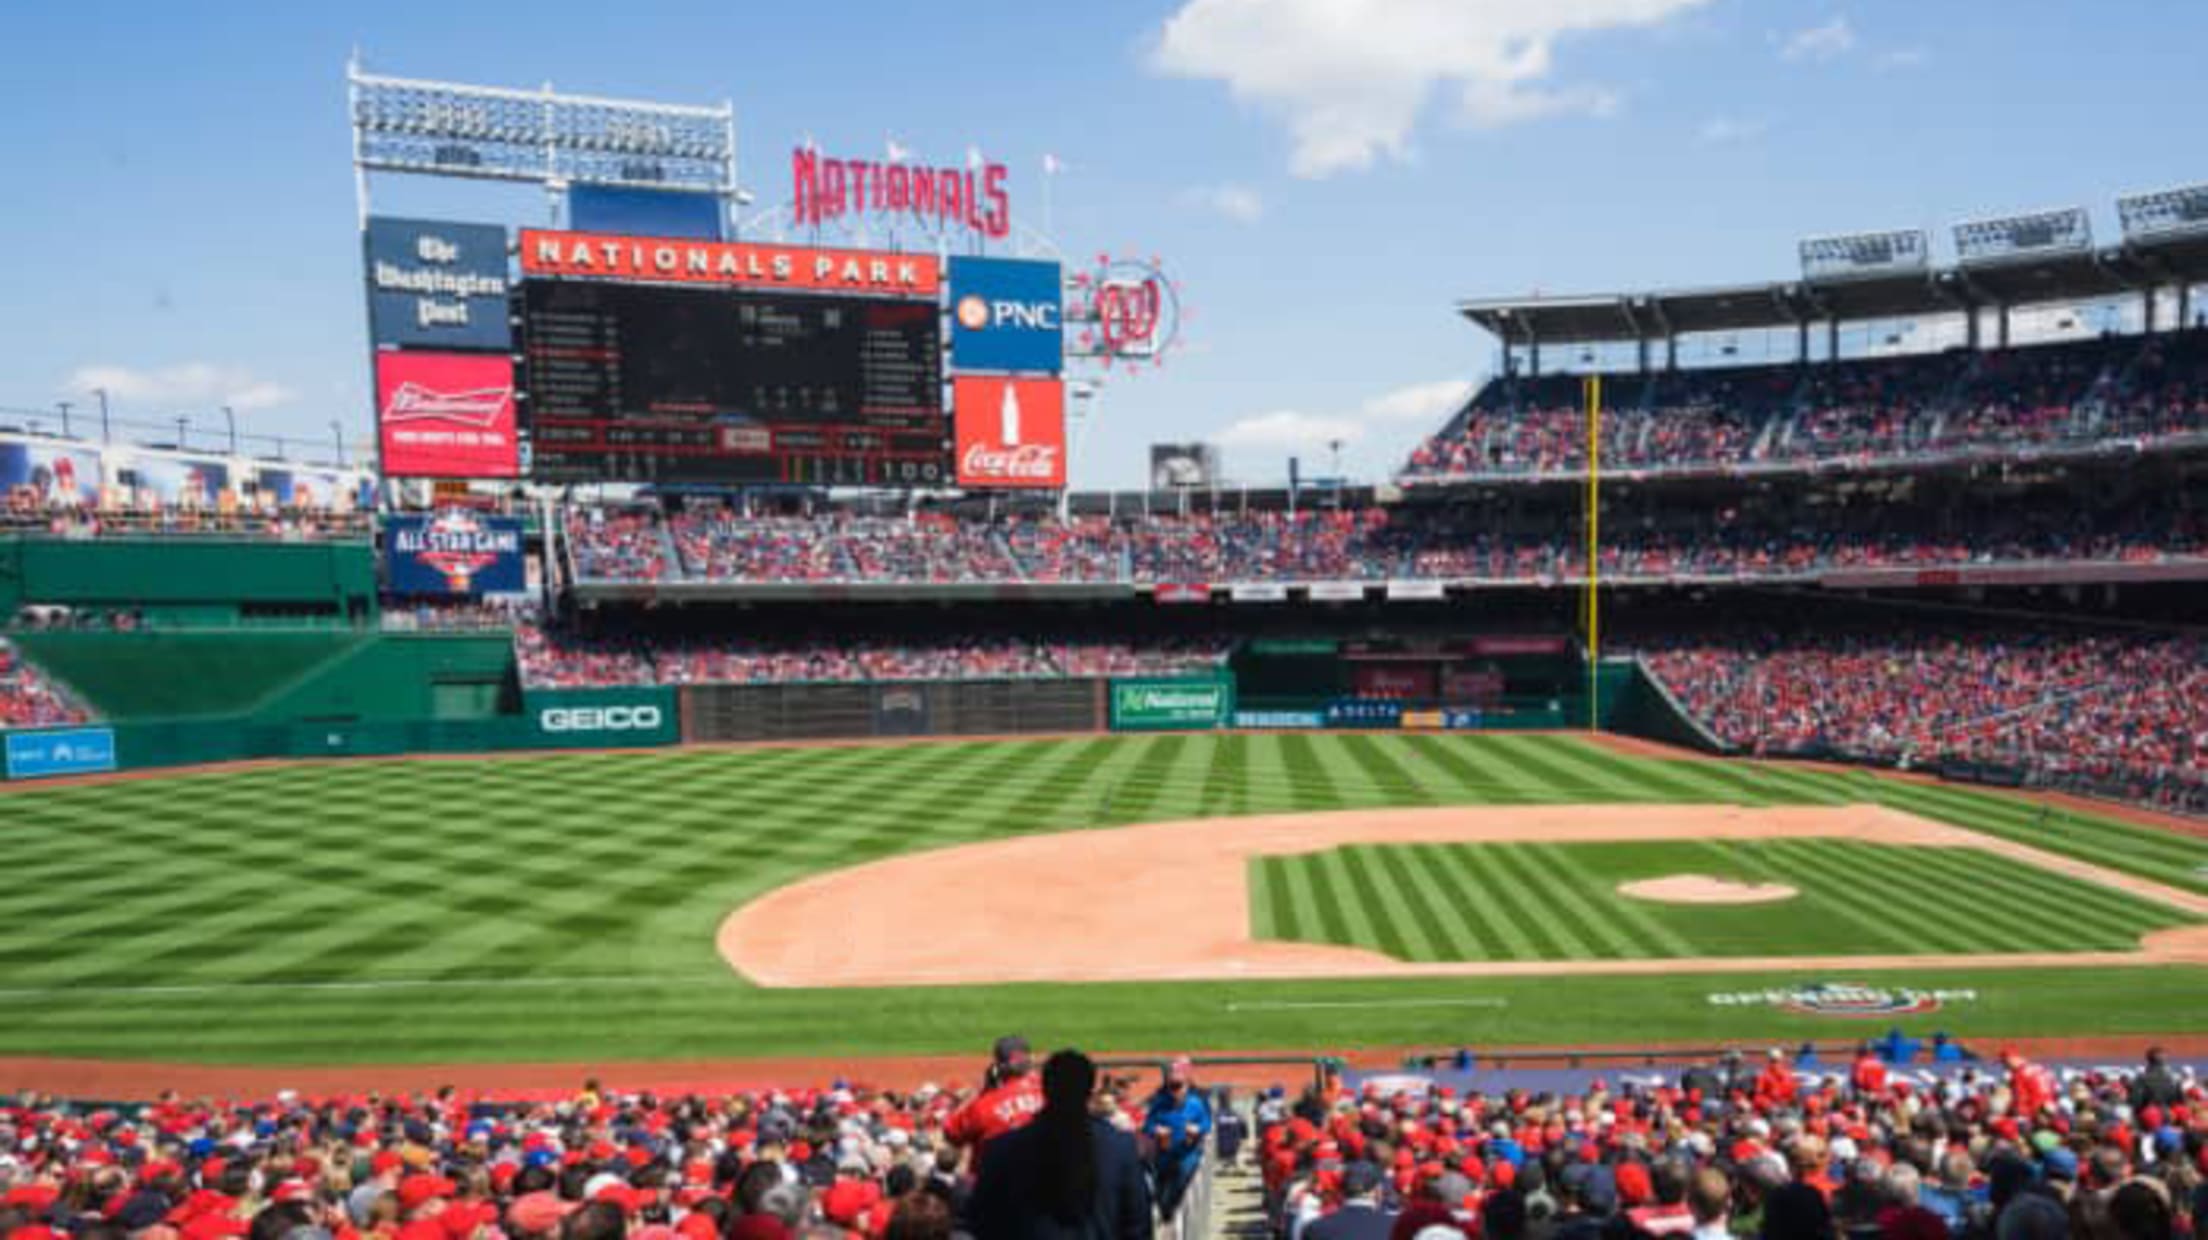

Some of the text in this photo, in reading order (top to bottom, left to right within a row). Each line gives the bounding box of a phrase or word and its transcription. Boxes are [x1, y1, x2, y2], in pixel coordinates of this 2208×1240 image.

[793, 145, 1010, 238] NATIONALS
[418, 234, 457, 262] The
[537, 239, 919, 284] NATIONALS PARK
[376, 261, 506, 298] Washington
[418, 298, 468, 328] Post
[992, 300, 1058, 329] PNC
[541, 705, 661, 731] GEICO
